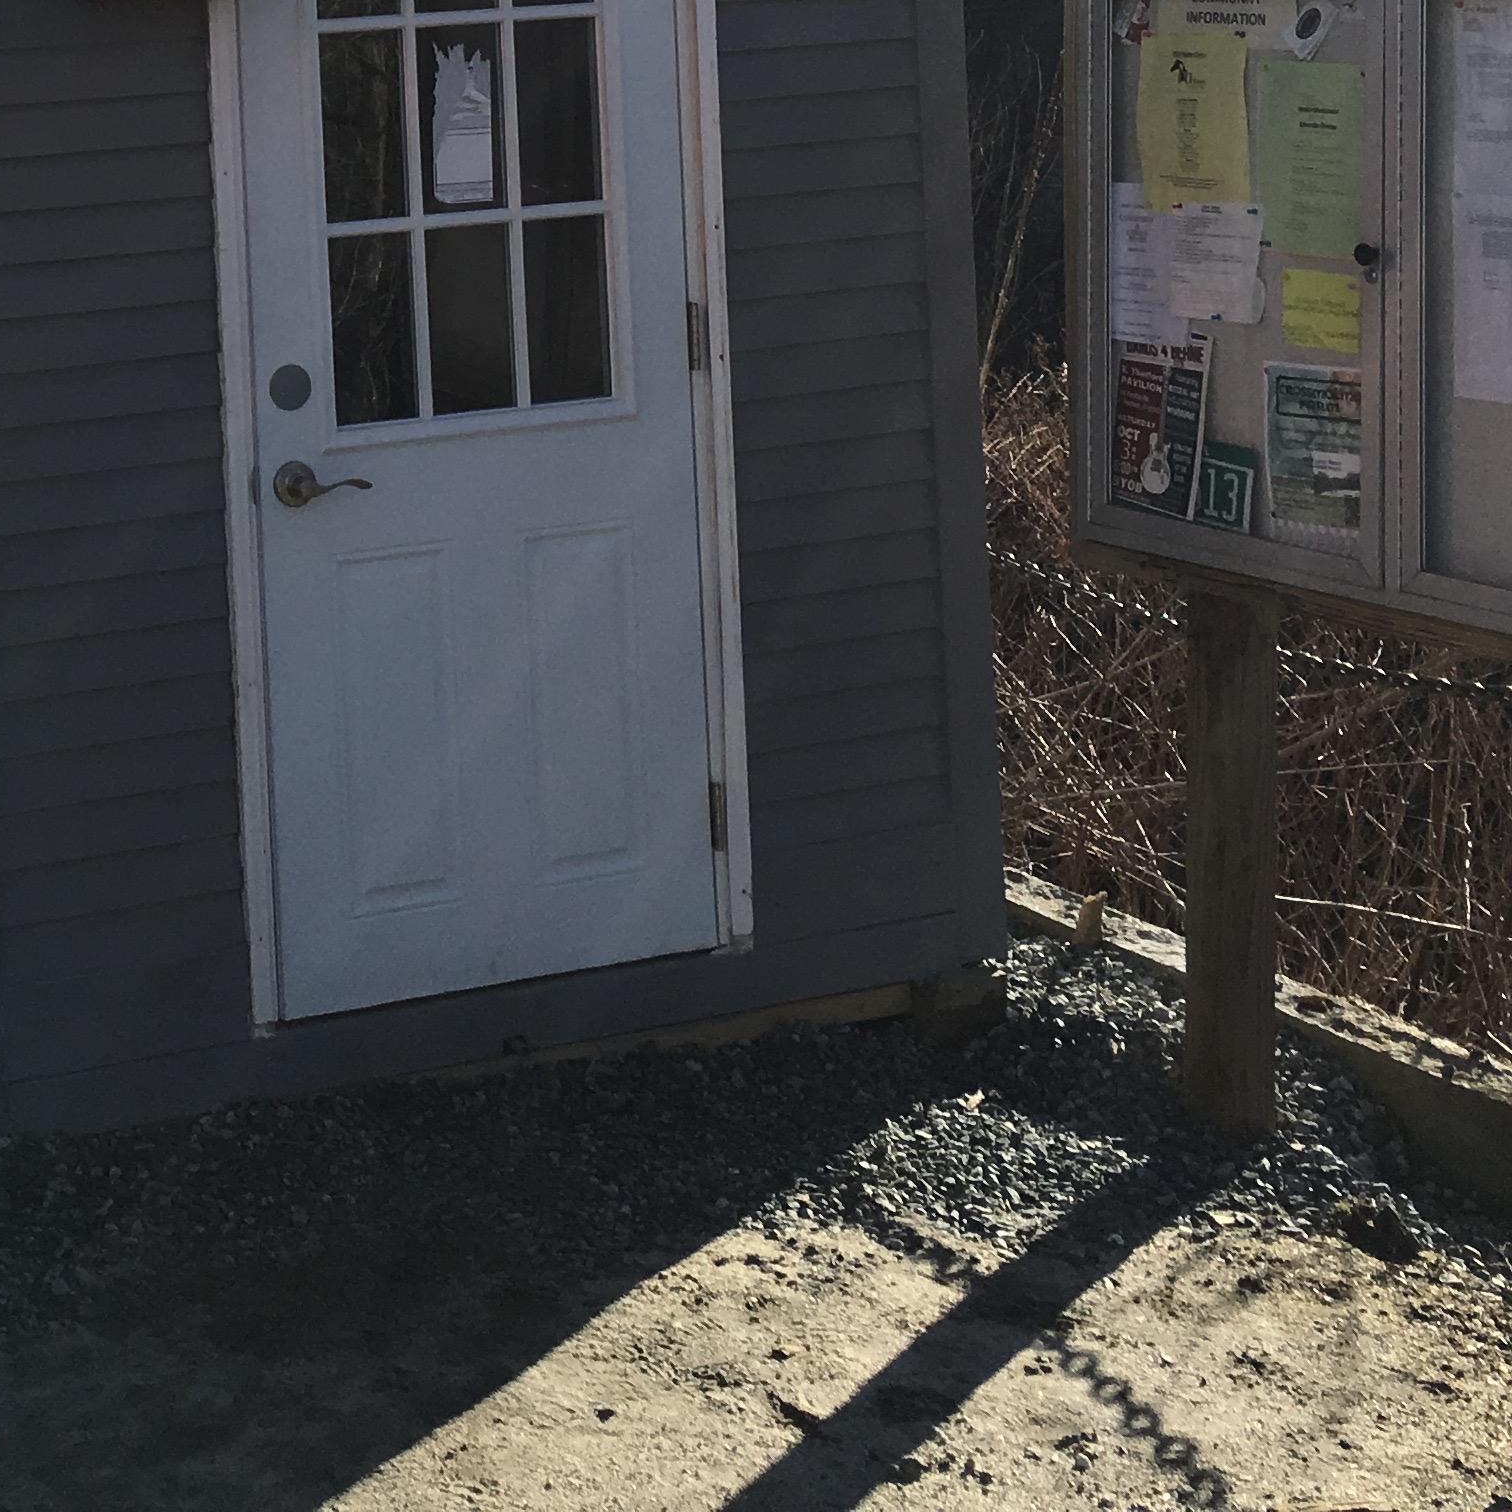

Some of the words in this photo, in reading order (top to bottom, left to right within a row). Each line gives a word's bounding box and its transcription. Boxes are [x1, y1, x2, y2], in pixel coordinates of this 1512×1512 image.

[1186, 11, 1266, 26] INFORMATION
[1120, 375, 1162, 394] PAVILION
[1117, 425, 1140, 441] OCT
[1203, 468, 1240, 522] 13
